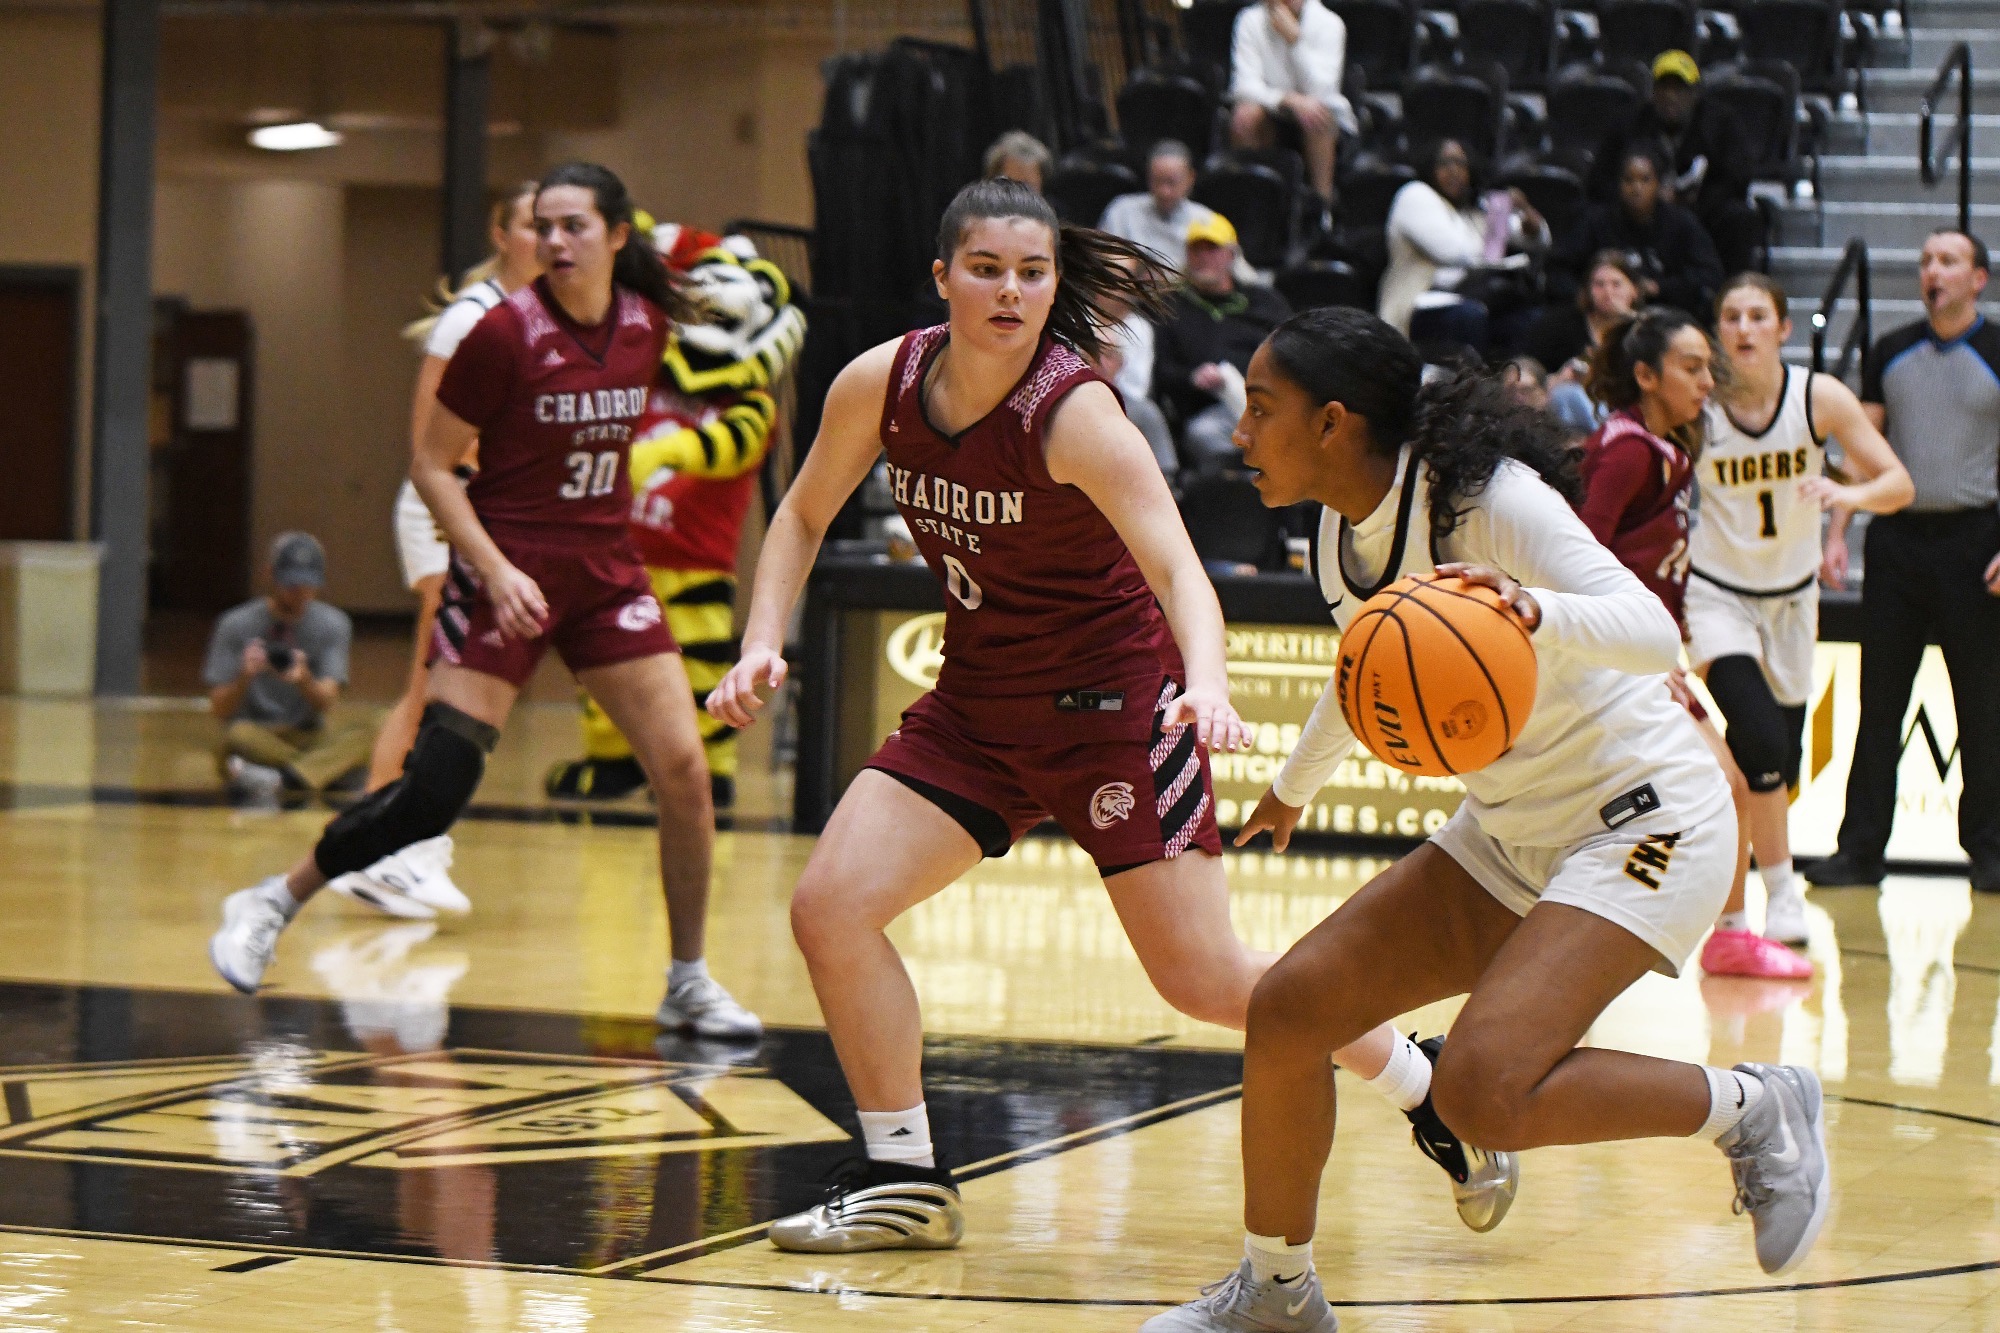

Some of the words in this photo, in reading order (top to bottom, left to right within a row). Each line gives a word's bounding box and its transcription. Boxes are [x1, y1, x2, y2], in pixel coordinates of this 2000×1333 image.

[572, 424, 632, 445] STATE
[559, 451, 620, 499] 30
[1713, 447, 1808, 486] TIGERS
[1757, 490, 1778, 538] 1
[915, 518, 981, 554] STATE
[942, 554, 983, 611] 0
[1374, 701, 1422, 767] EVO
[1636, 793, 1651, 806] M
